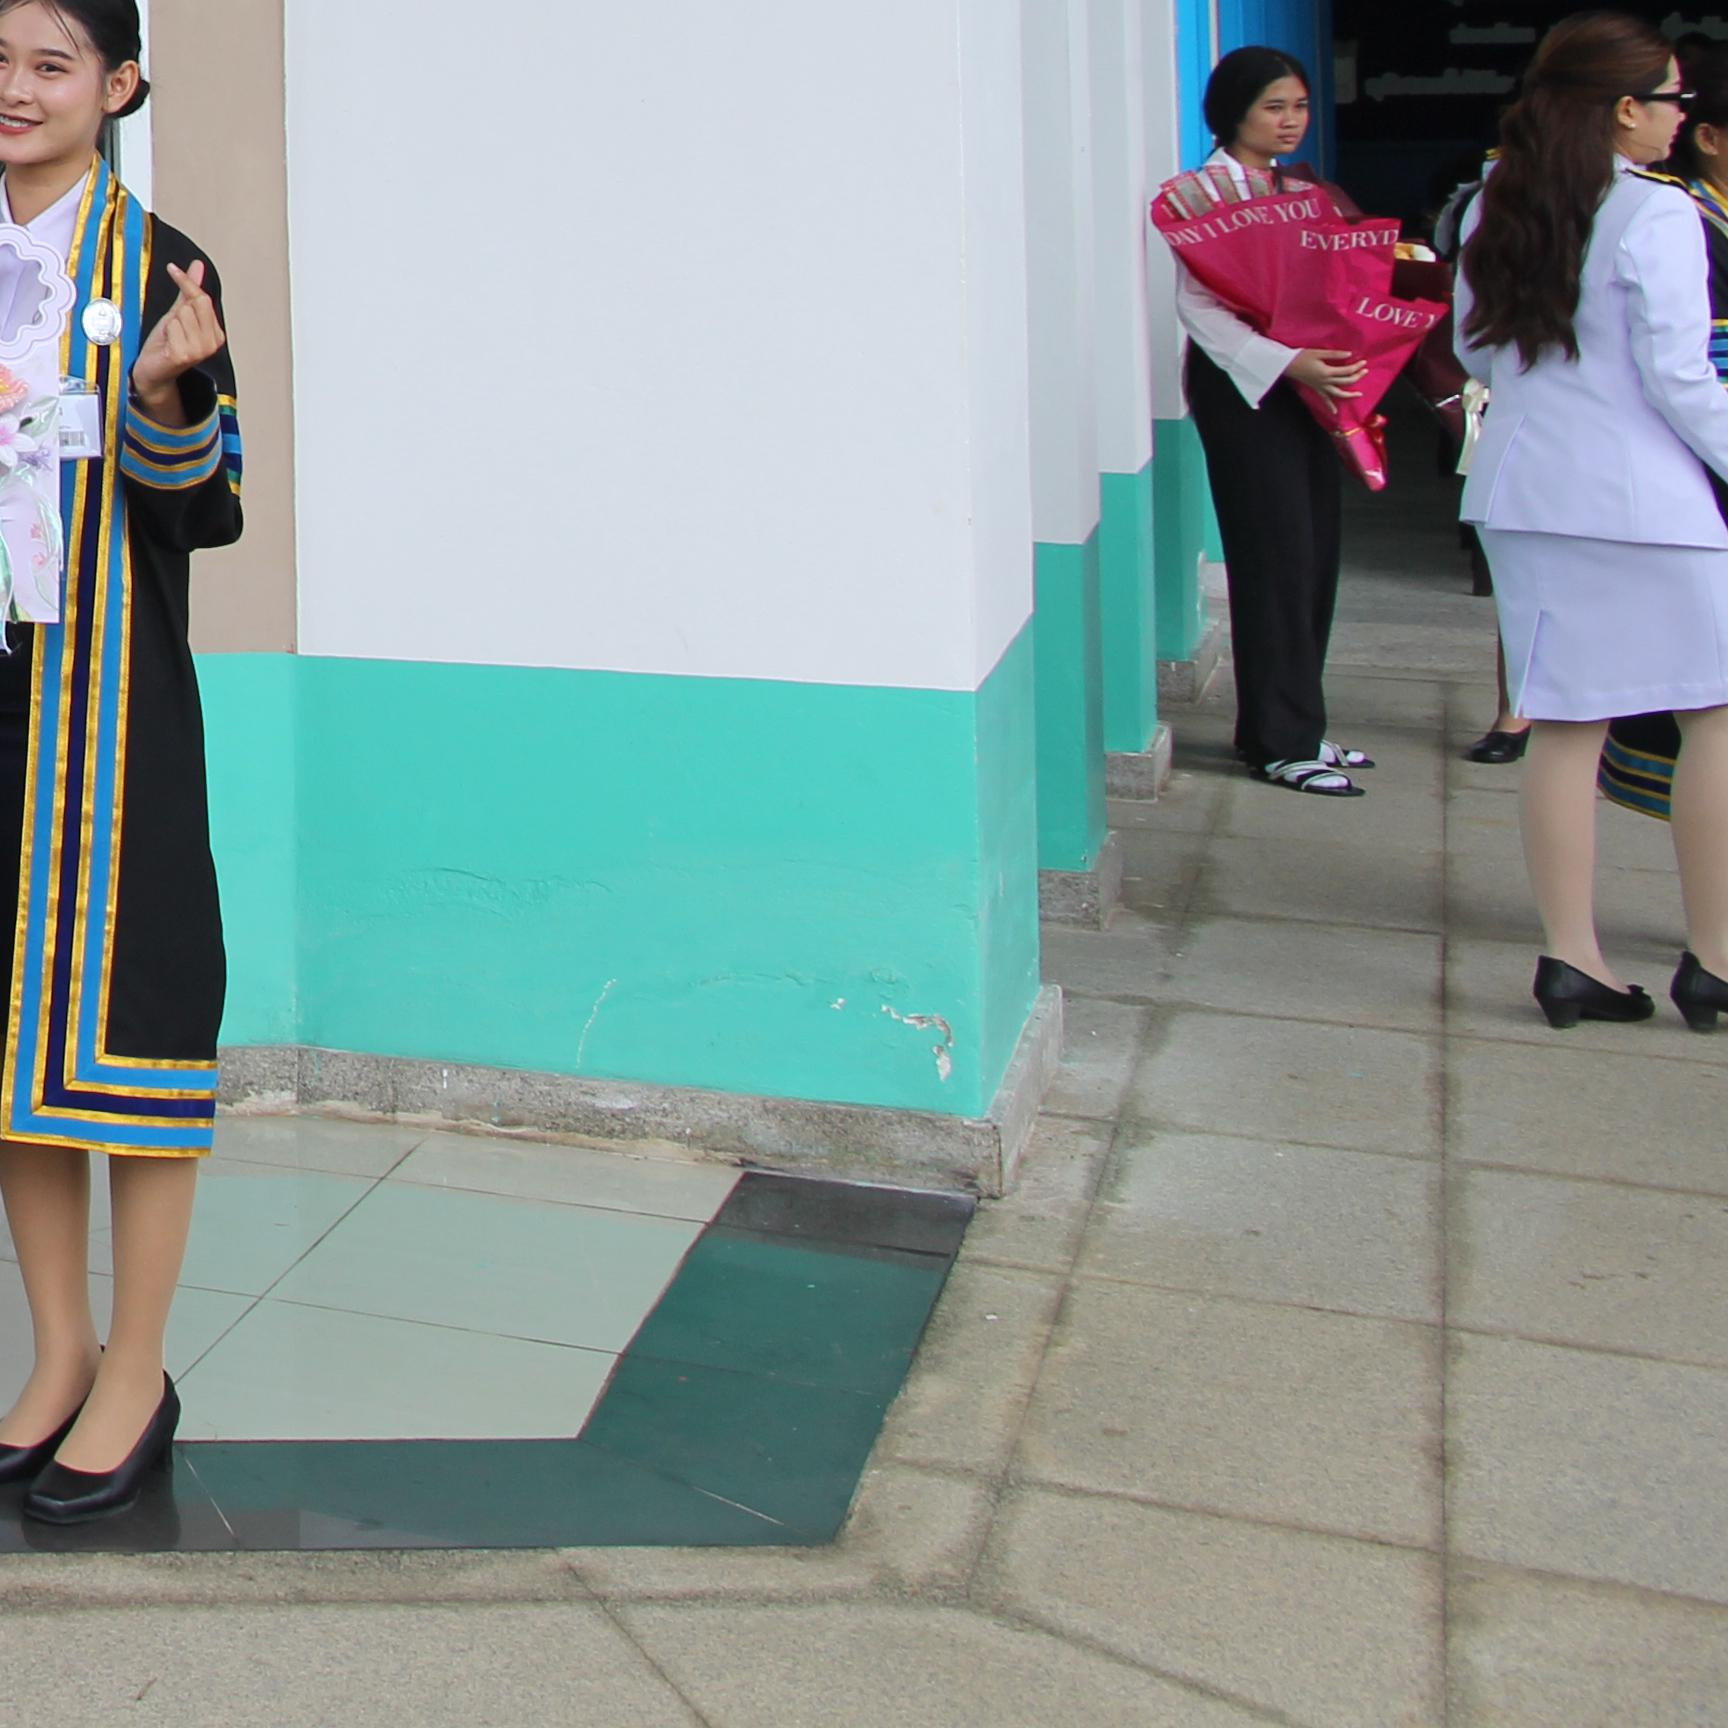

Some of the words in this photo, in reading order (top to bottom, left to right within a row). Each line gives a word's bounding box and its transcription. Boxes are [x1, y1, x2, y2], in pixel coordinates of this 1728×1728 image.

[1216, 206, 1275, 235] LOVE
[1274, 197, 1323, 223] YOU
[1355, 296, 1425, 329] LOVE
